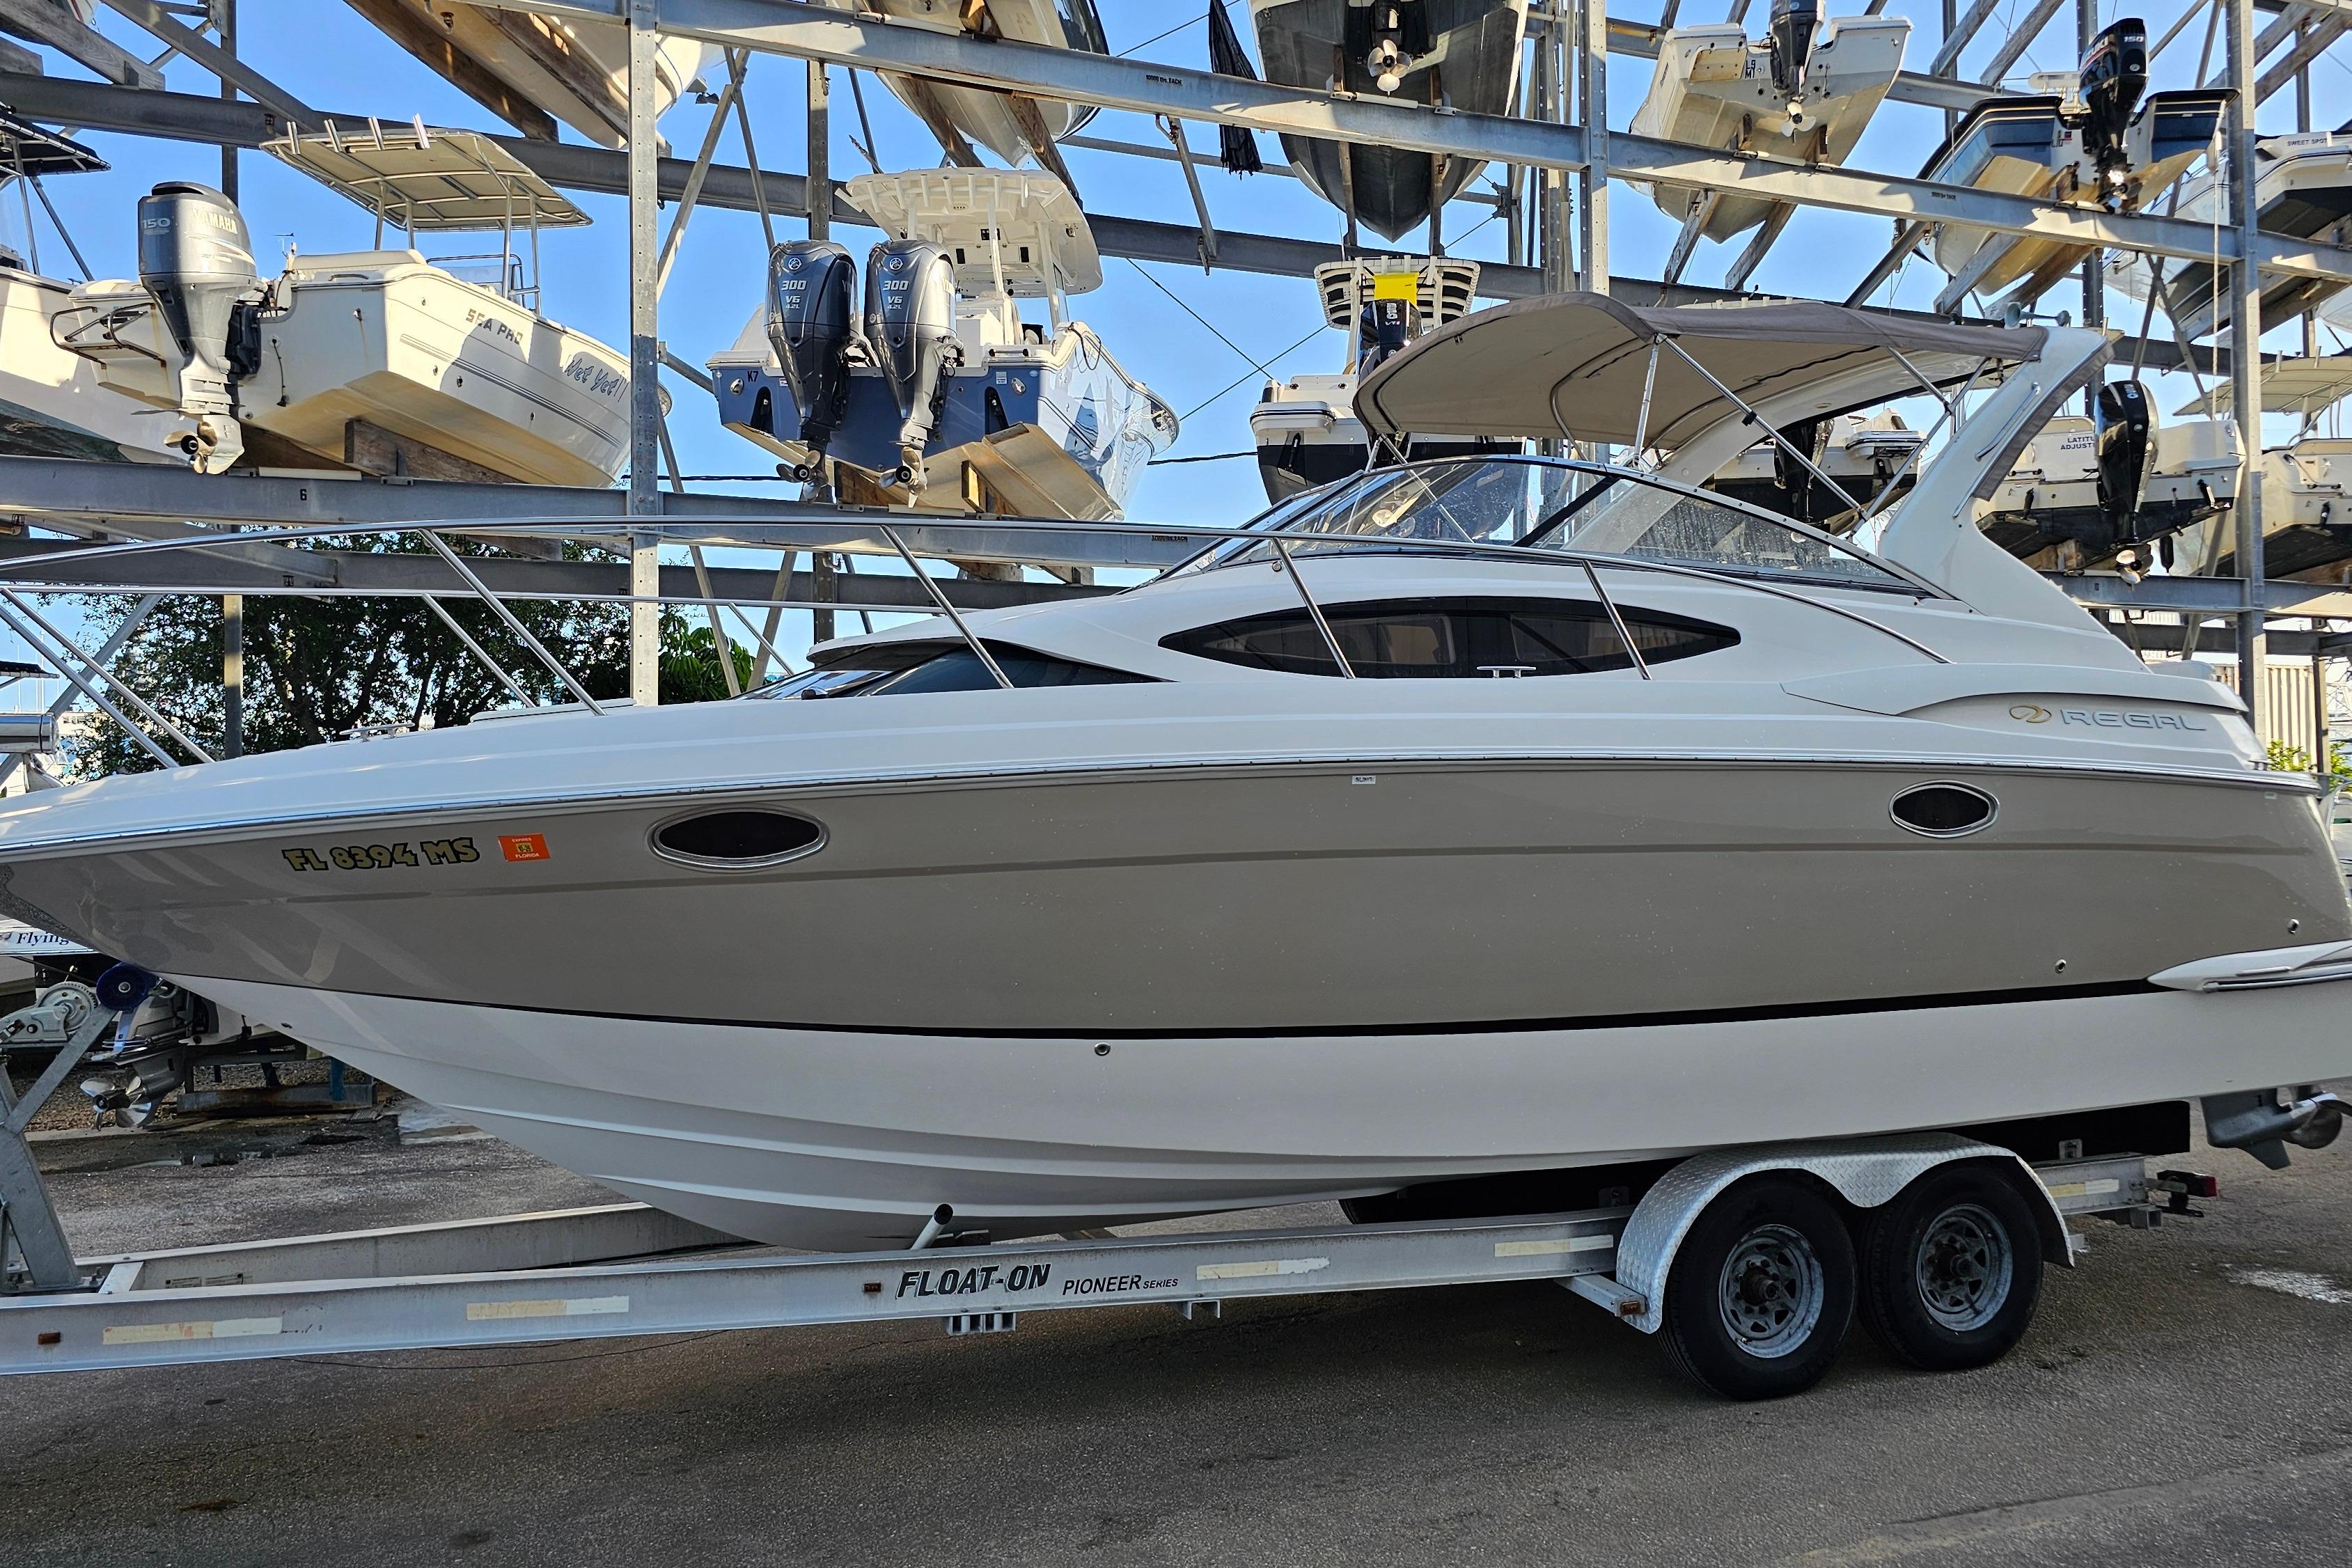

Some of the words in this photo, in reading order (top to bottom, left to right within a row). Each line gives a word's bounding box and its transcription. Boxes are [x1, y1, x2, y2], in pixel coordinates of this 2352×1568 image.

[142, 217, 171, 229] 150
[191, 207, 238, 235] YAMAHA
[781, 280, 807, 291] 300
[882, 280, 909, 291] 300
[785, 295, 801, 304] V6
[465, 308, 492, 331] SEA
[496, 324, 524, 346] PRO
[747, 370, 759, 382] K7
[299, 488, 308, 501] 6
[2060, 708, 2208, 731] REGAL
[281, 847, 329, 872] FL
[329, 842, 421, 870] 8394
[420, 837, 480, 865] MS
[895, 1263, 1052, 1300] FLOAT-ON
[1063, 1274, 1142, 1295] PIONEER
[1142, 1278, 1179, 1289] SERIES
